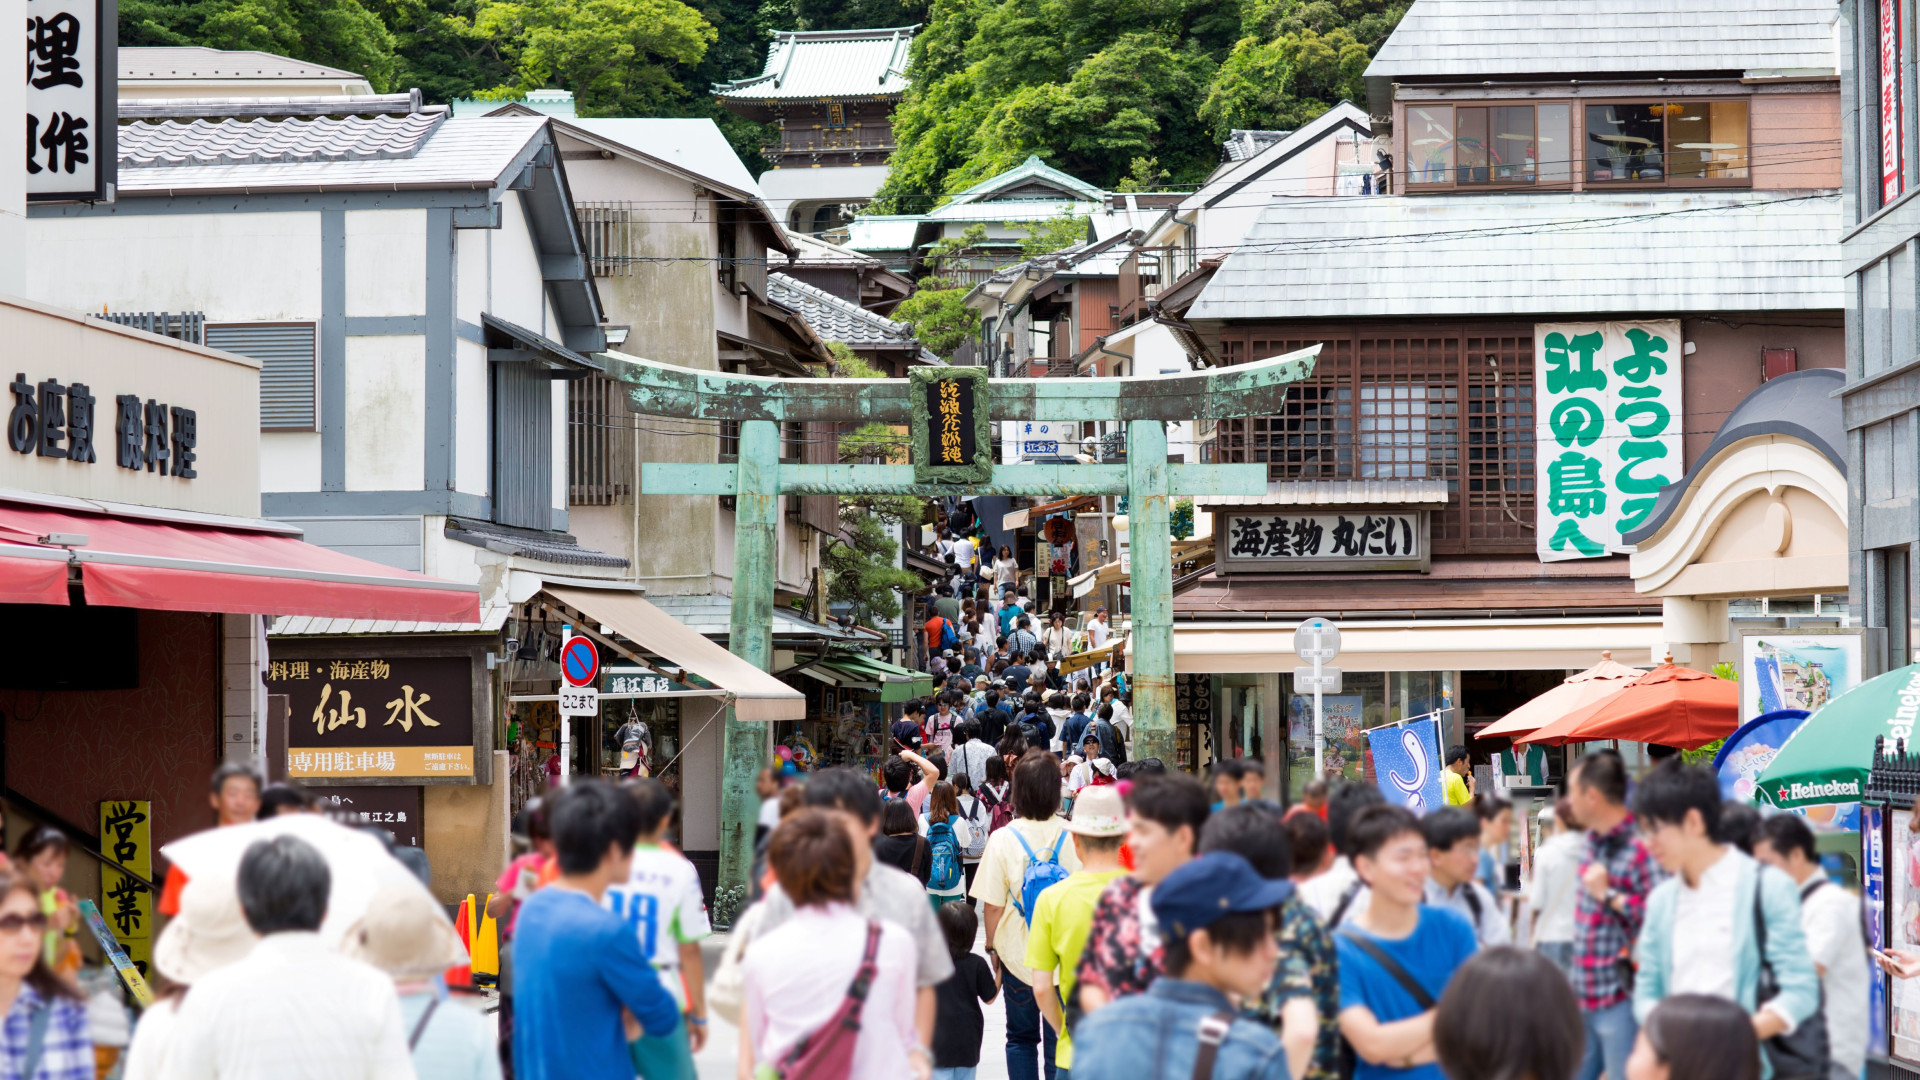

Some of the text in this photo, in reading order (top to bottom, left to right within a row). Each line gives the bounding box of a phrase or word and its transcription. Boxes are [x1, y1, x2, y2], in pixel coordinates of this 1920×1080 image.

[8, 372, 197, 479] お座敷 磯料理
[1544, 330, 1607, 556] 江の島へ
[1231, 515, 1413, 557] 海産物 丸だい
[563, 695, 594, 709] ここまで
[1790, 779, 1860, 800] Heineken
